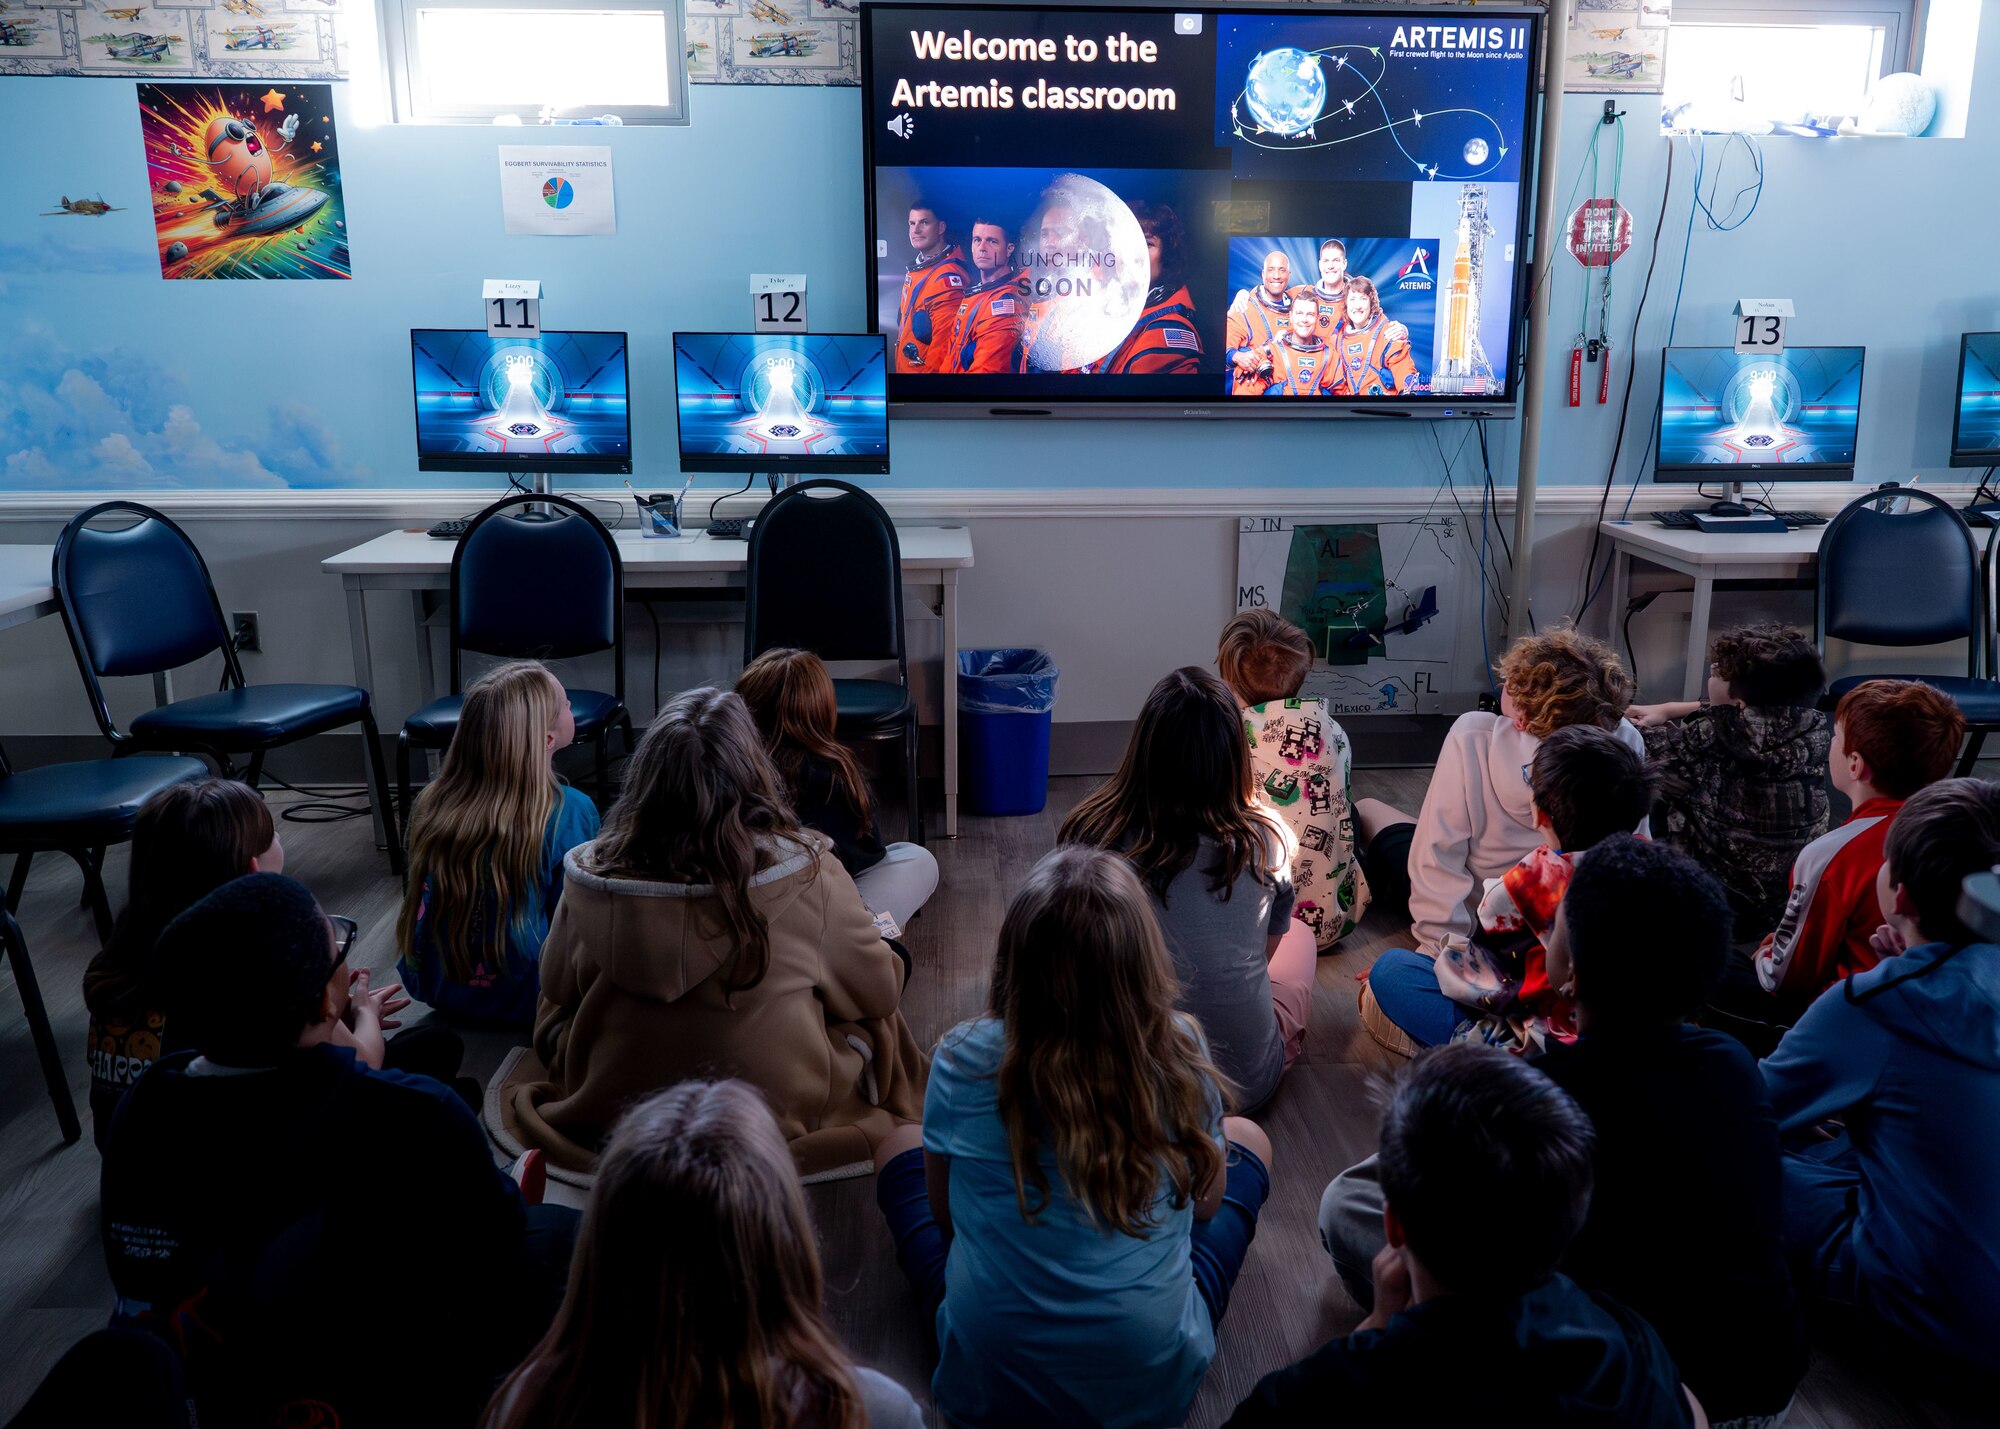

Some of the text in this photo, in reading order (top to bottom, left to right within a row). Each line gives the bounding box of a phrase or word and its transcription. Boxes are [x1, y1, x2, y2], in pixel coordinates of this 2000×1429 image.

[910, 29, 1158, 63] Welcome to the
[1390, 26, 1525, 50] ARTEMIS II
[1405, 50, 1429, 58] crewed
[1430, 50, 1446, 59] flight
[1485, 51, 1502, 59] since
[1503, 51, 1523, 60] Apollo
[891, 78, 1176, 111] Artemis classroom
[994, 252, 1116, 268] LAUNCHING
[1018, 277, 1092, 297] SOON
[1399, 282, 1432, 290] ARTEMIS
[492, 298, 535, 329] 11
[760, 291, 802, 322] 12
[1741, 315, 1781, 345] 13
[505, 355, 534, 368] 9:00
[766, 357, 795, 370] 9:00
[1750, 370, 1777, 382] 9:00
[1261, 517, 1282, 532] TN
[1443, 528, 1454, 538] SC
[1320, 538, 1350, 559] AL
[1239, 585, 1265, 607] MS
[1414, 671, 1439, 694] FL
[1334, 702, 1371, 713] MEXICO
